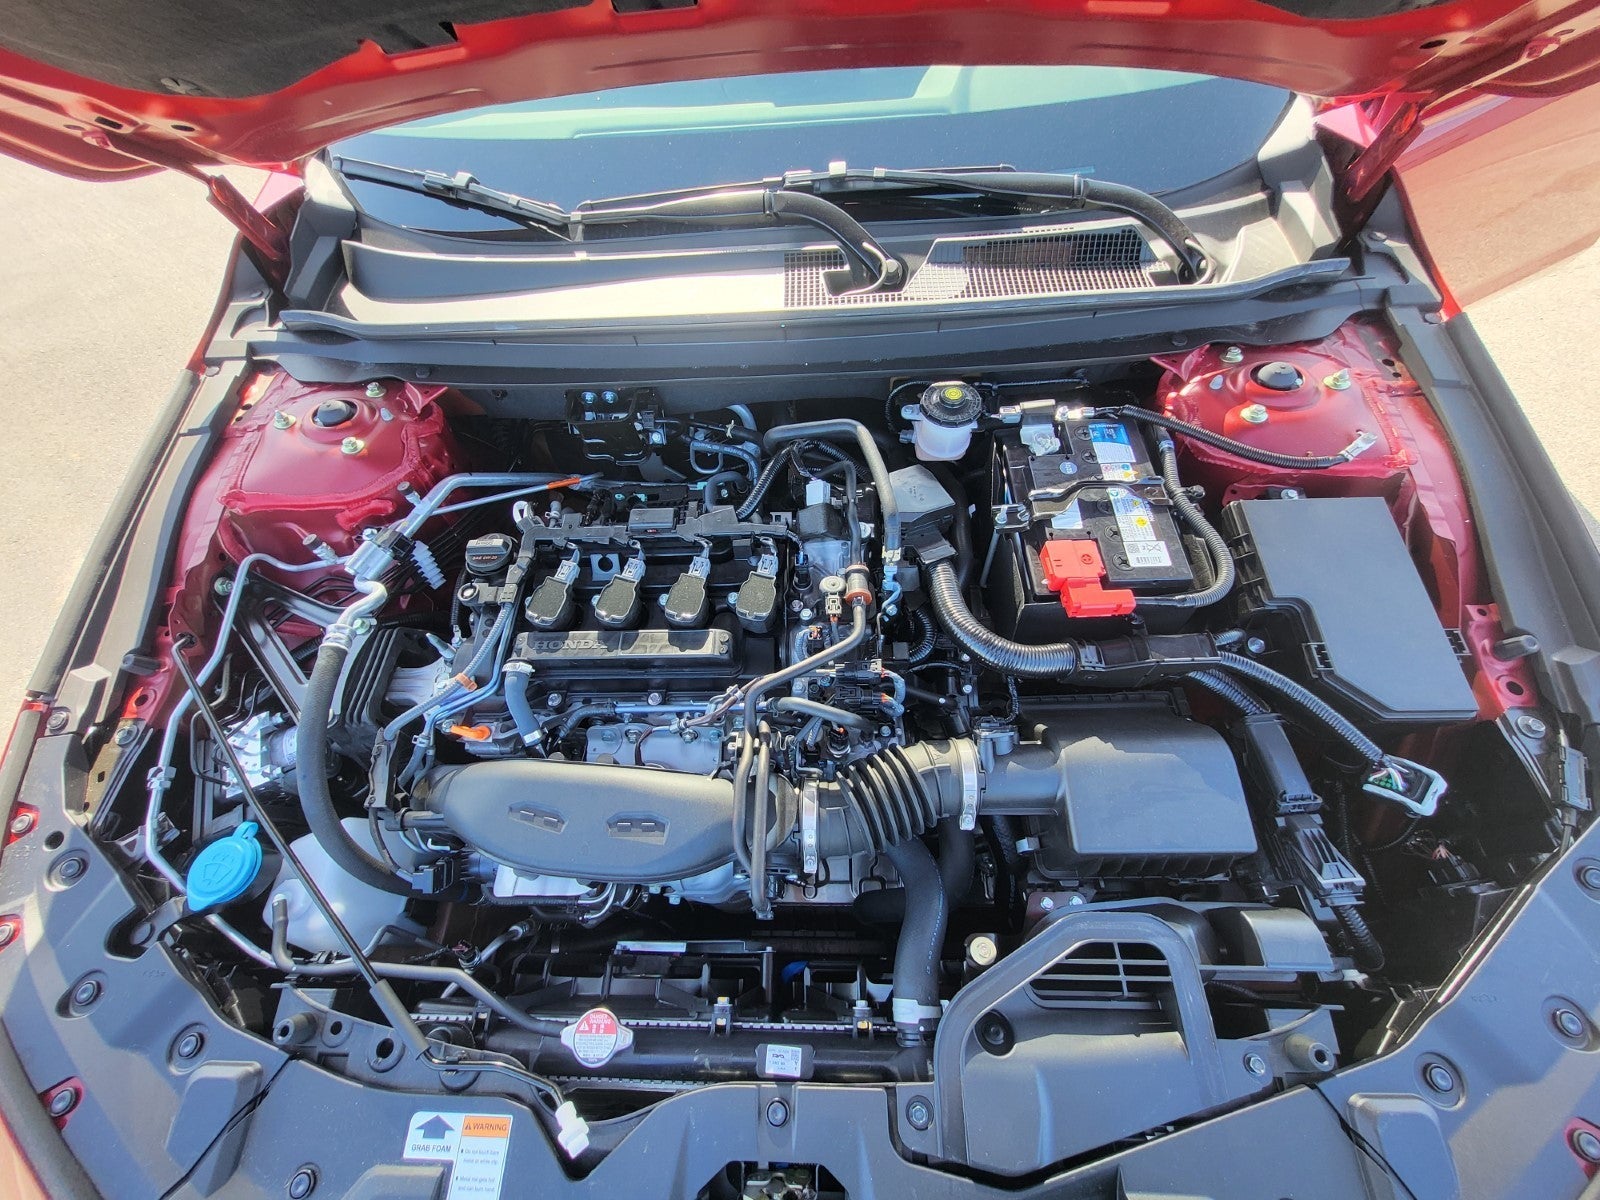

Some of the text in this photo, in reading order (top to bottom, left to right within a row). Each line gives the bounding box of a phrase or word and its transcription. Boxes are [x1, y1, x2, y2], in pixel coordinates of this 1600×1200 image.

[533, 639, 608, 651] HONDA
[473, 1122, 508, 1131] WARNING
[411, 1143, 452, 1153] GRAB FOAM
